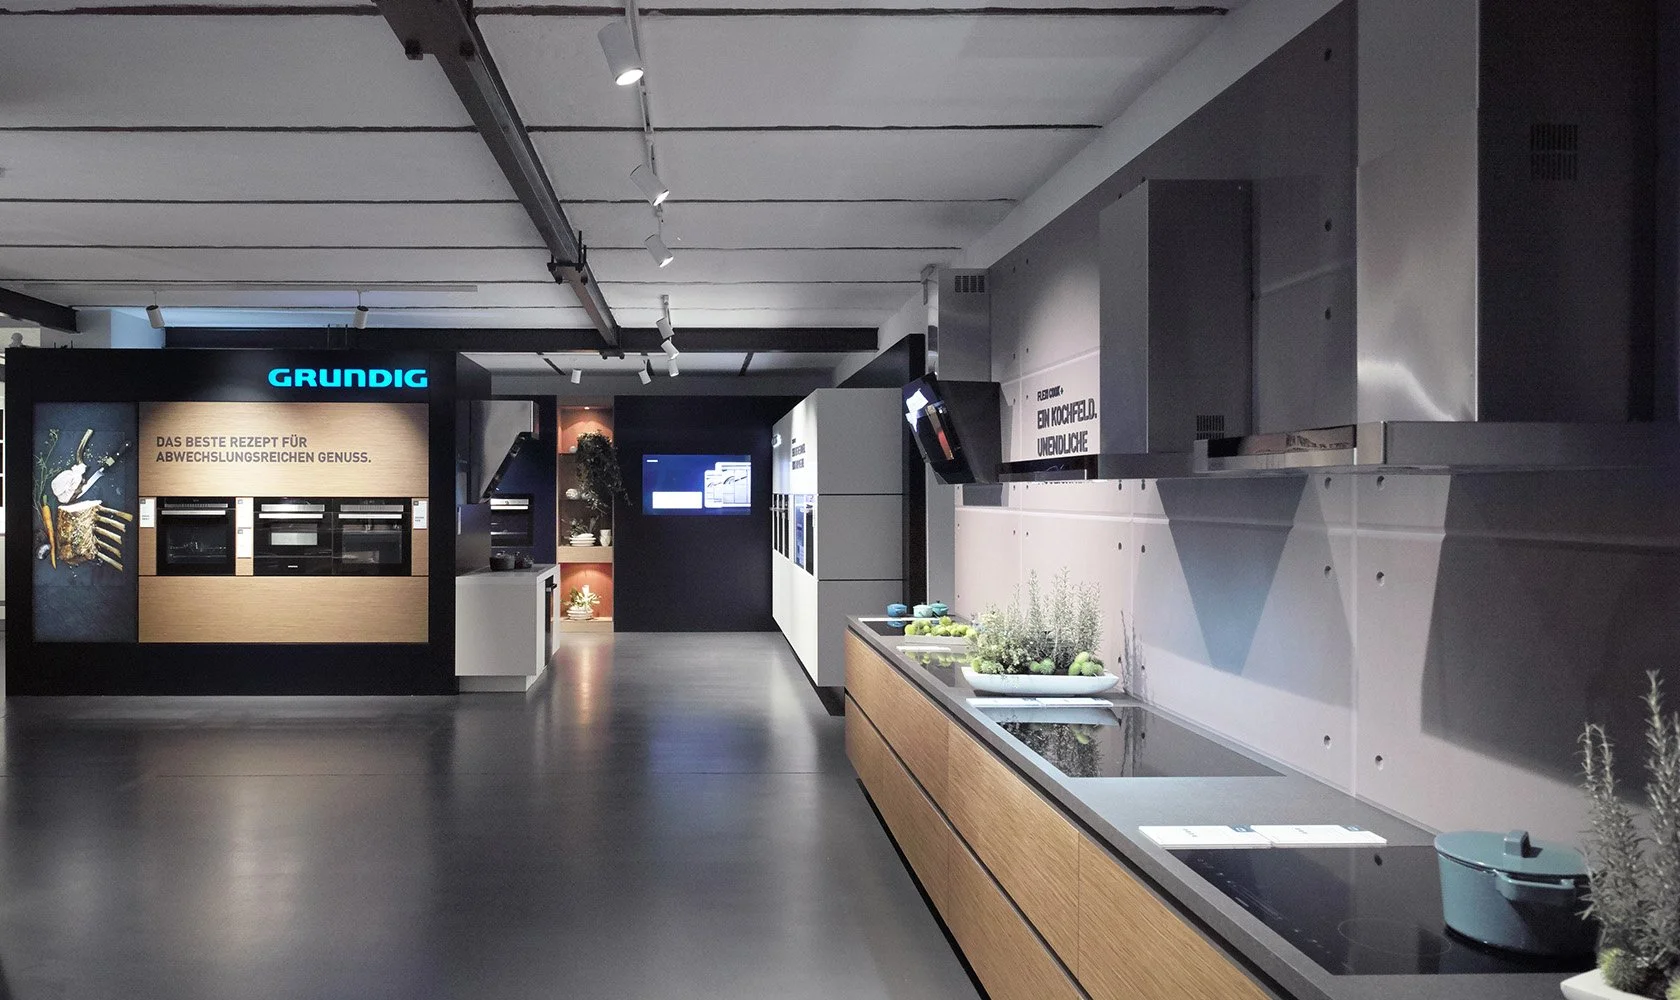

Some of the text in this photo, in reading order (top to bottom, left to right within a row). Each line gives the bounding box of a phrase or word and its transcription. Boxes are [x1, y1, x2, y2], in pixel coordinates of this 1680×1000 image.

[268, 368, 428, 388] GRUNDIG
[1037, 398, 1098, 429] EIN KOCHFELD.
[156, 434, 308, 448] DAS BESTE REZEPT FÜR
[1037, 430, 1088, 457] UNENDLICHE
[156, 451, 372, 463] ABWECHSLUNGSREICHEN GENUSS.
